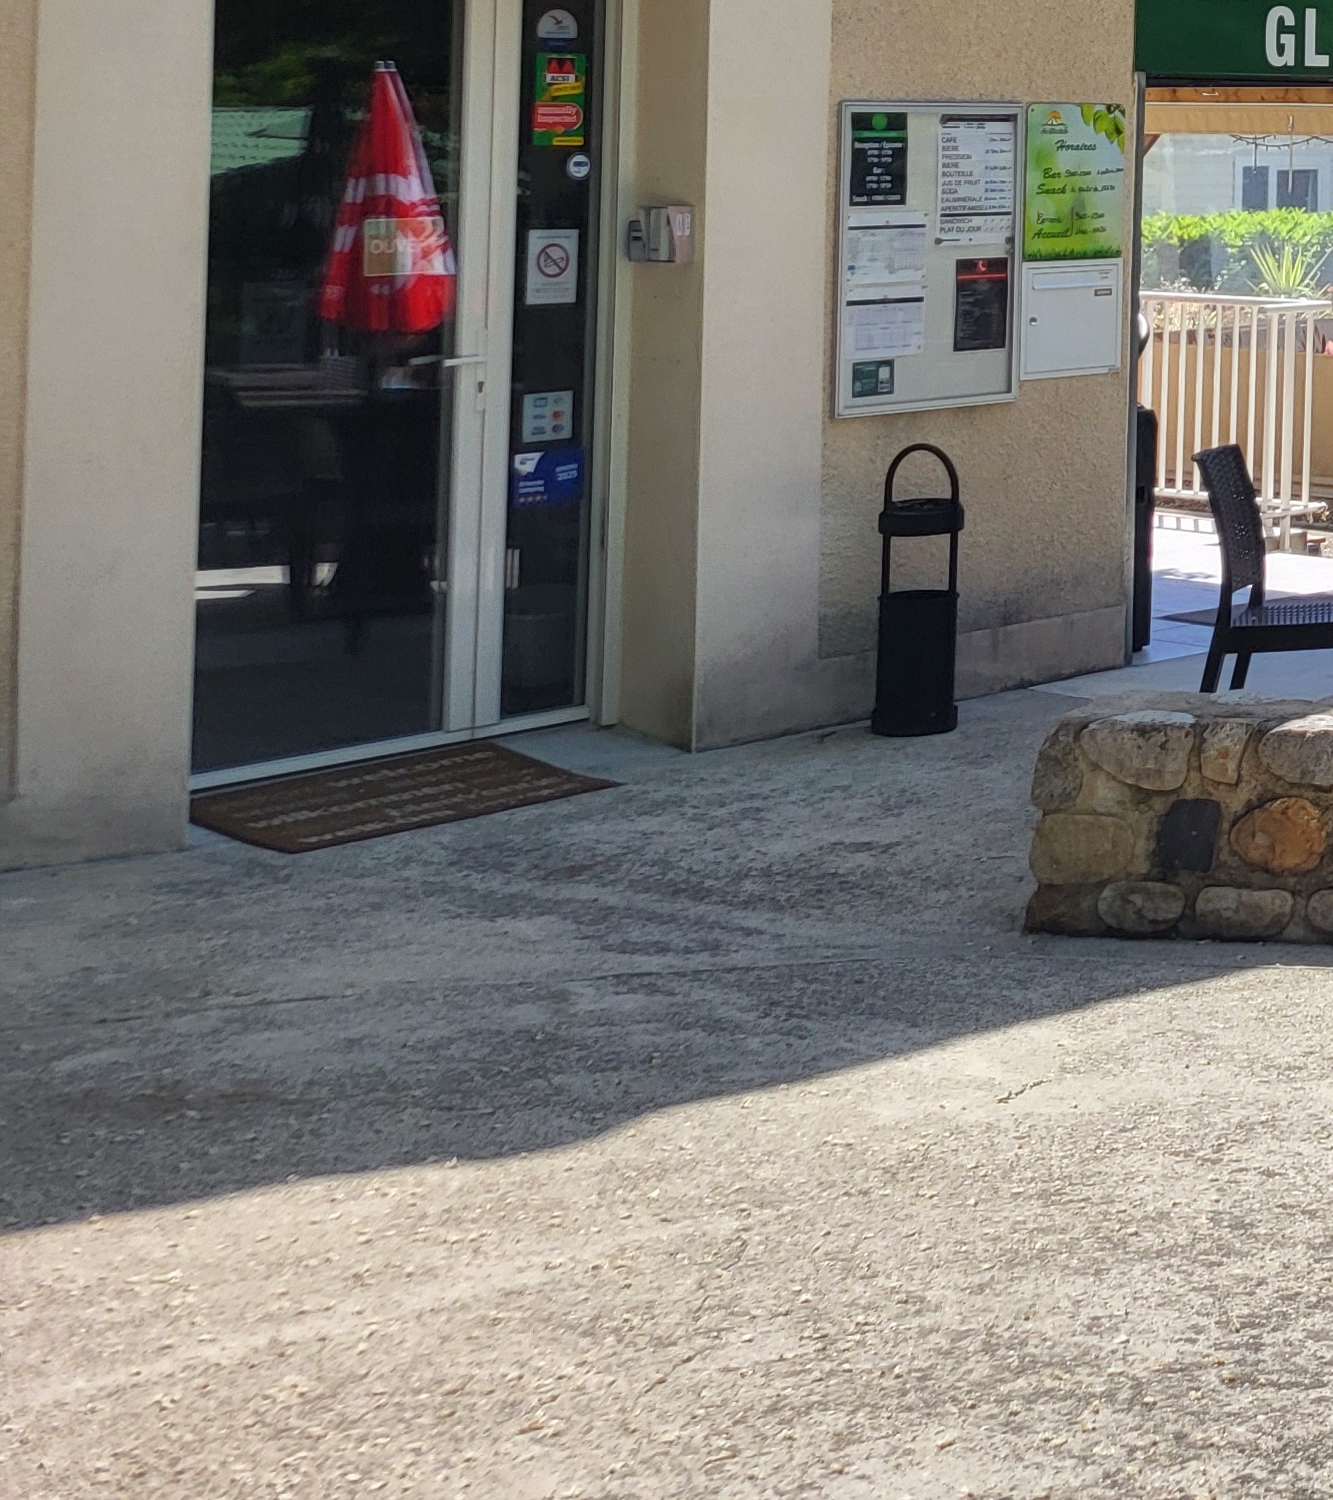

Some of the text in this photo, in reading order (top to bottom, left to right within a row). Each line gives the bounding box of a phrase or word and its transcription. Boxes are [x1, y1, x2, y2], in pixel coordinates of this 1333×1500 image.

[1055, 139, 1097, 151] Horaires
[1043, 168, 1061, 179] Bar
[1036, 183, 1067, 195] Snack
